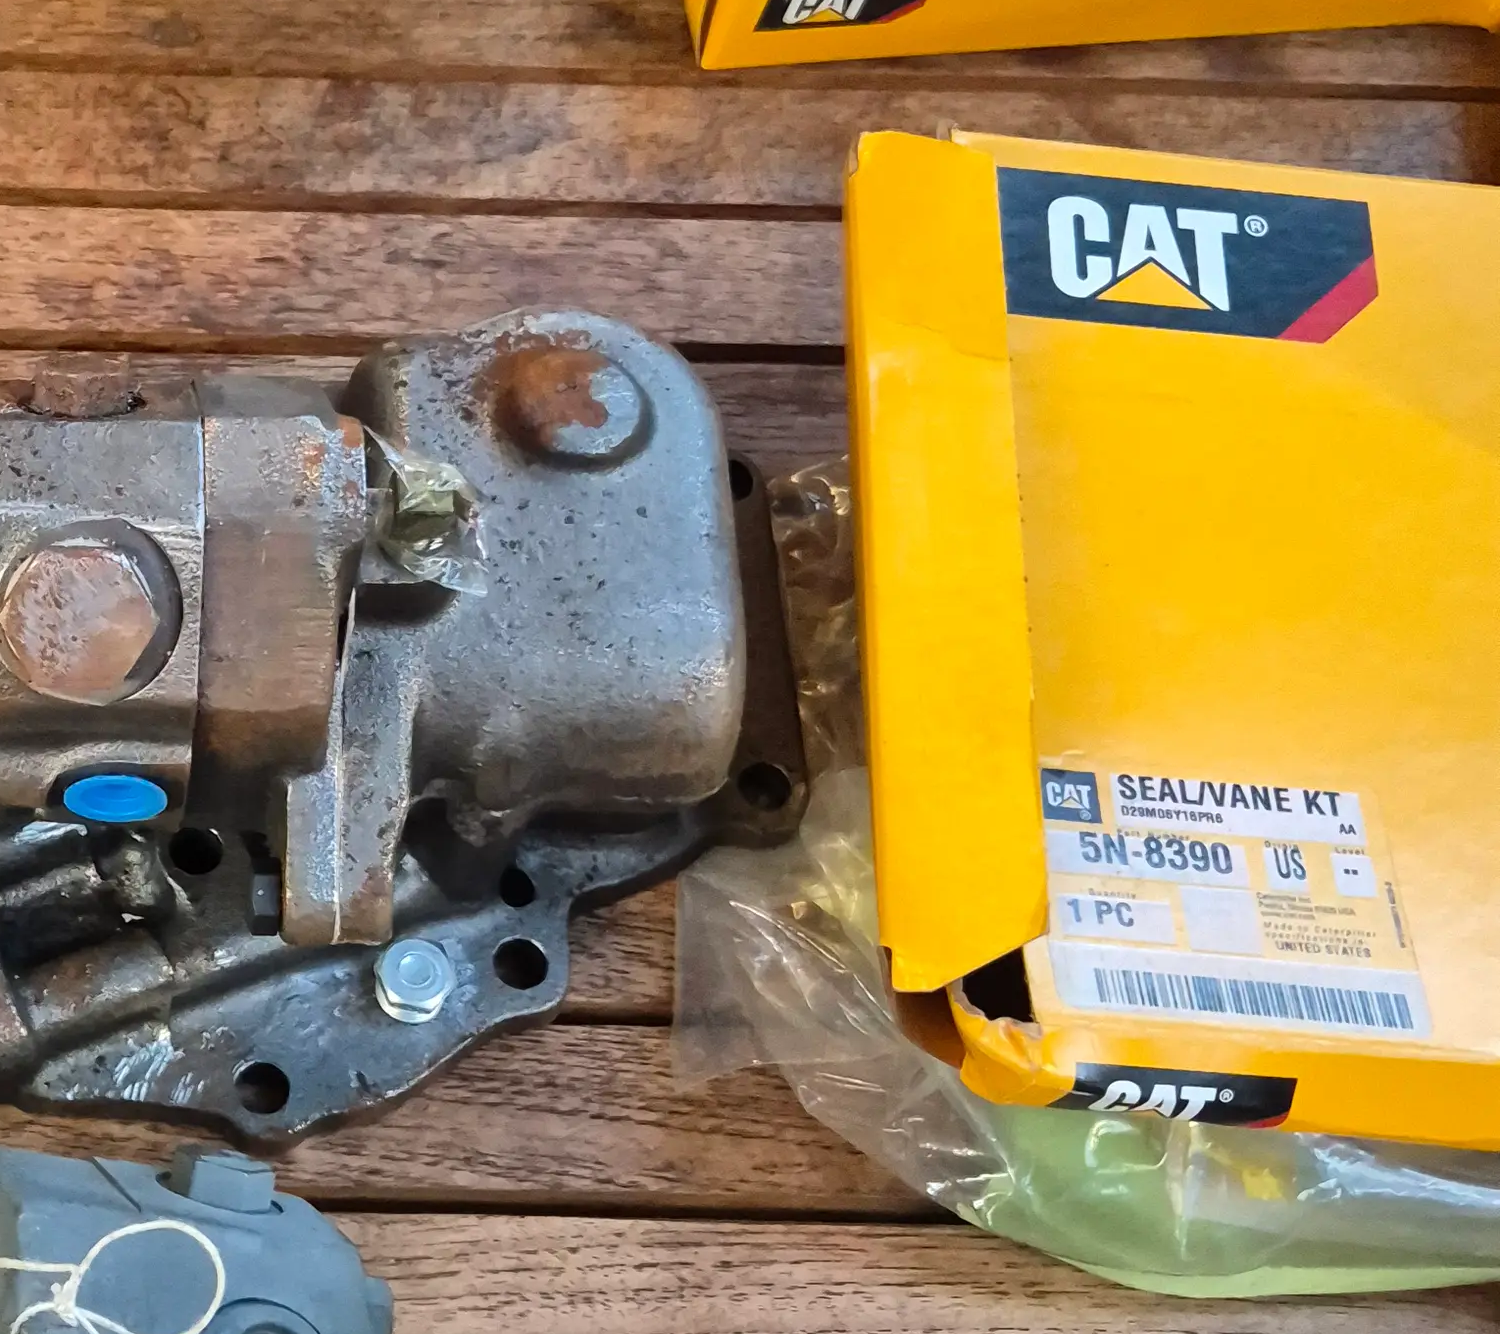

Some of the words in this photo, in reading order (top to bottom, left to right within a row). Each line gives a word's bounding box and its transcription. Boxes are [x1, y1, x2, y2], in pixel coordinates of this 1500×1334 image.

[1047, 195, 1239, 312] CAT
[1045, 781, 1092, 810] CAT
[1117, 773, 1293, 814] SEAL/VANE
[1303, 789, 1341, 818] KT
[1339, 823, 1357, 835] AA
[1079, 831, 1233, 875] 5N-8390
[1273, 846, 1307, 881] US
[1066, 898, 1082, 923] 1
[1094, 900, 1135, 928] PC
[1275, 940, 1321, 954] UNITED
[1325, 944, 1372, 959] STATES
